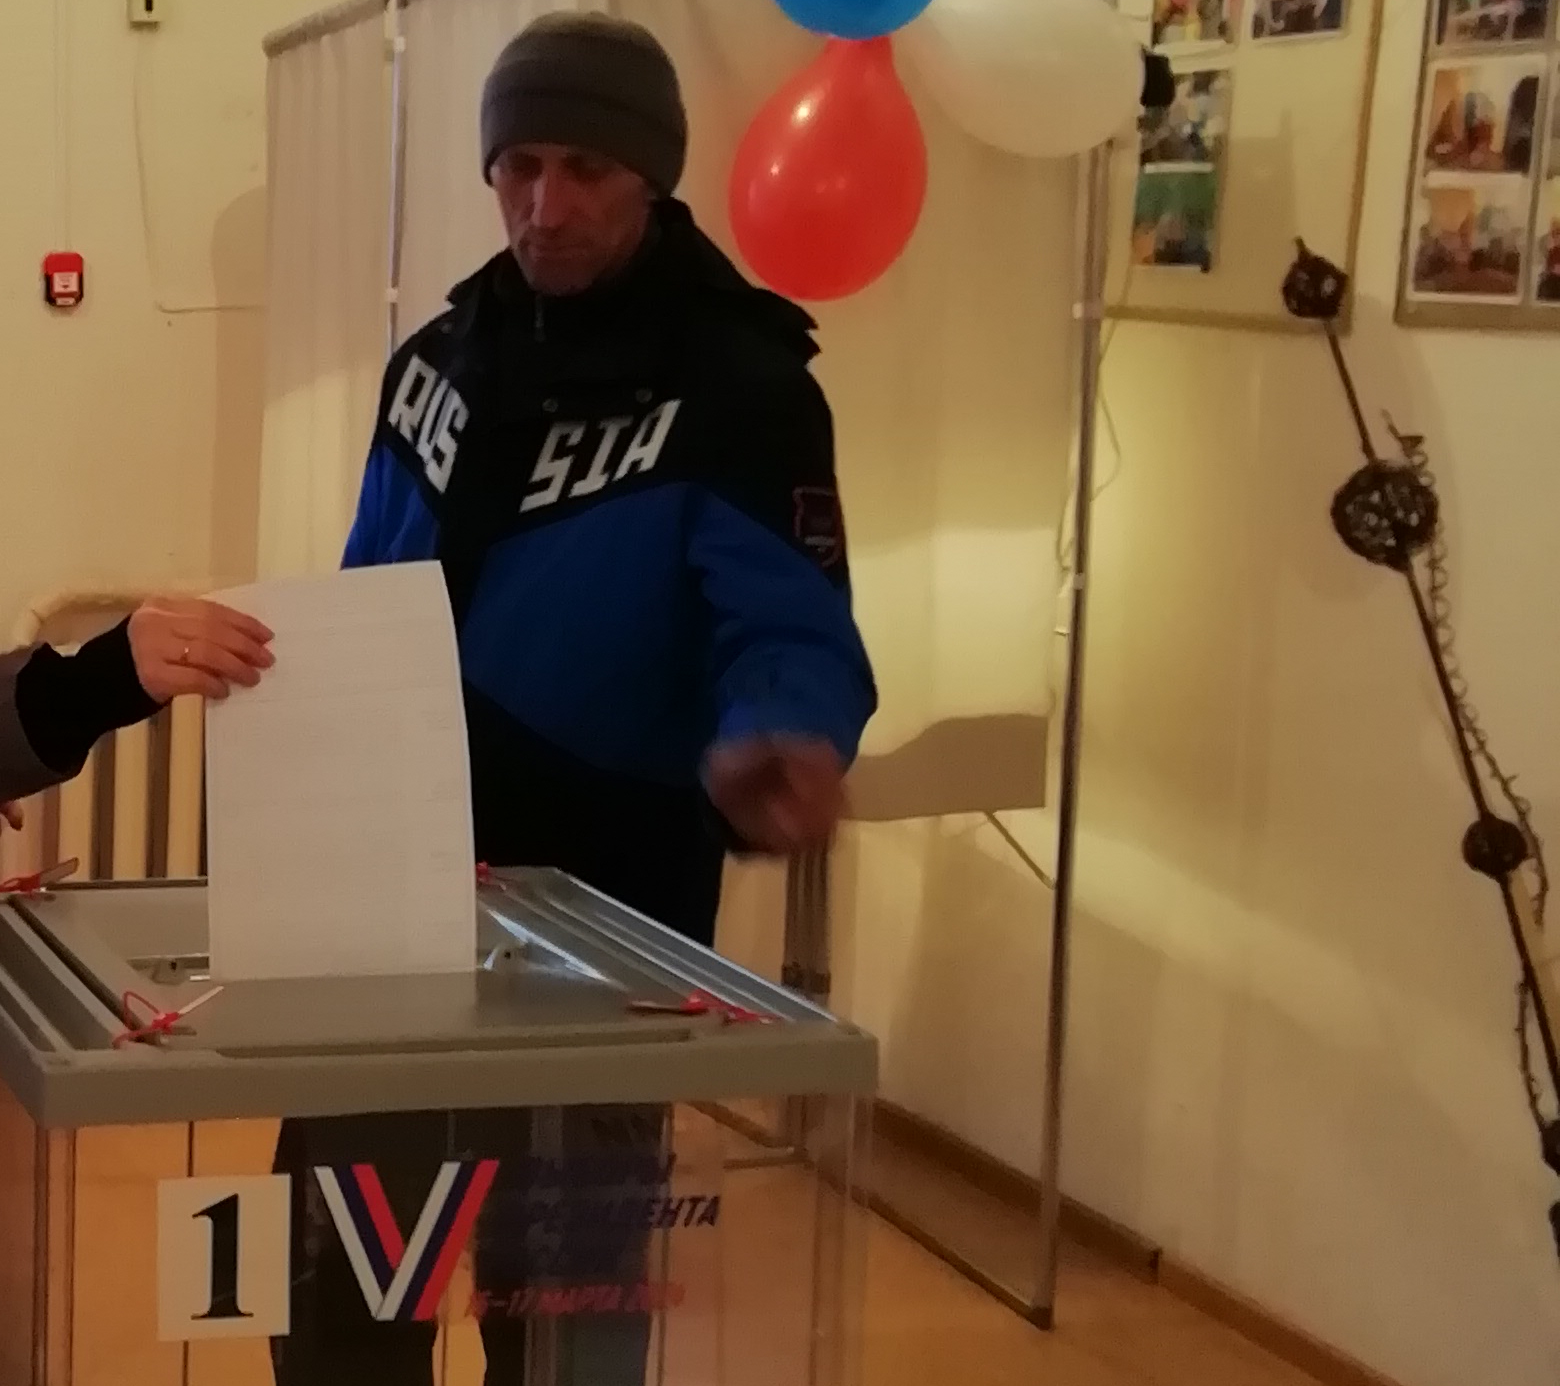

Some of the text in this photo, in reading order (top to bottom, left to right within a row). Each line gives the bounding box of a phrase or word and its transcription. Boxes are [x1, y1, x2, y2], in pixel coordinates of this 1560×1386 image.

[387, 352, 682, 514] RUS SIA
[191, 1192, 254, 1321] 1
